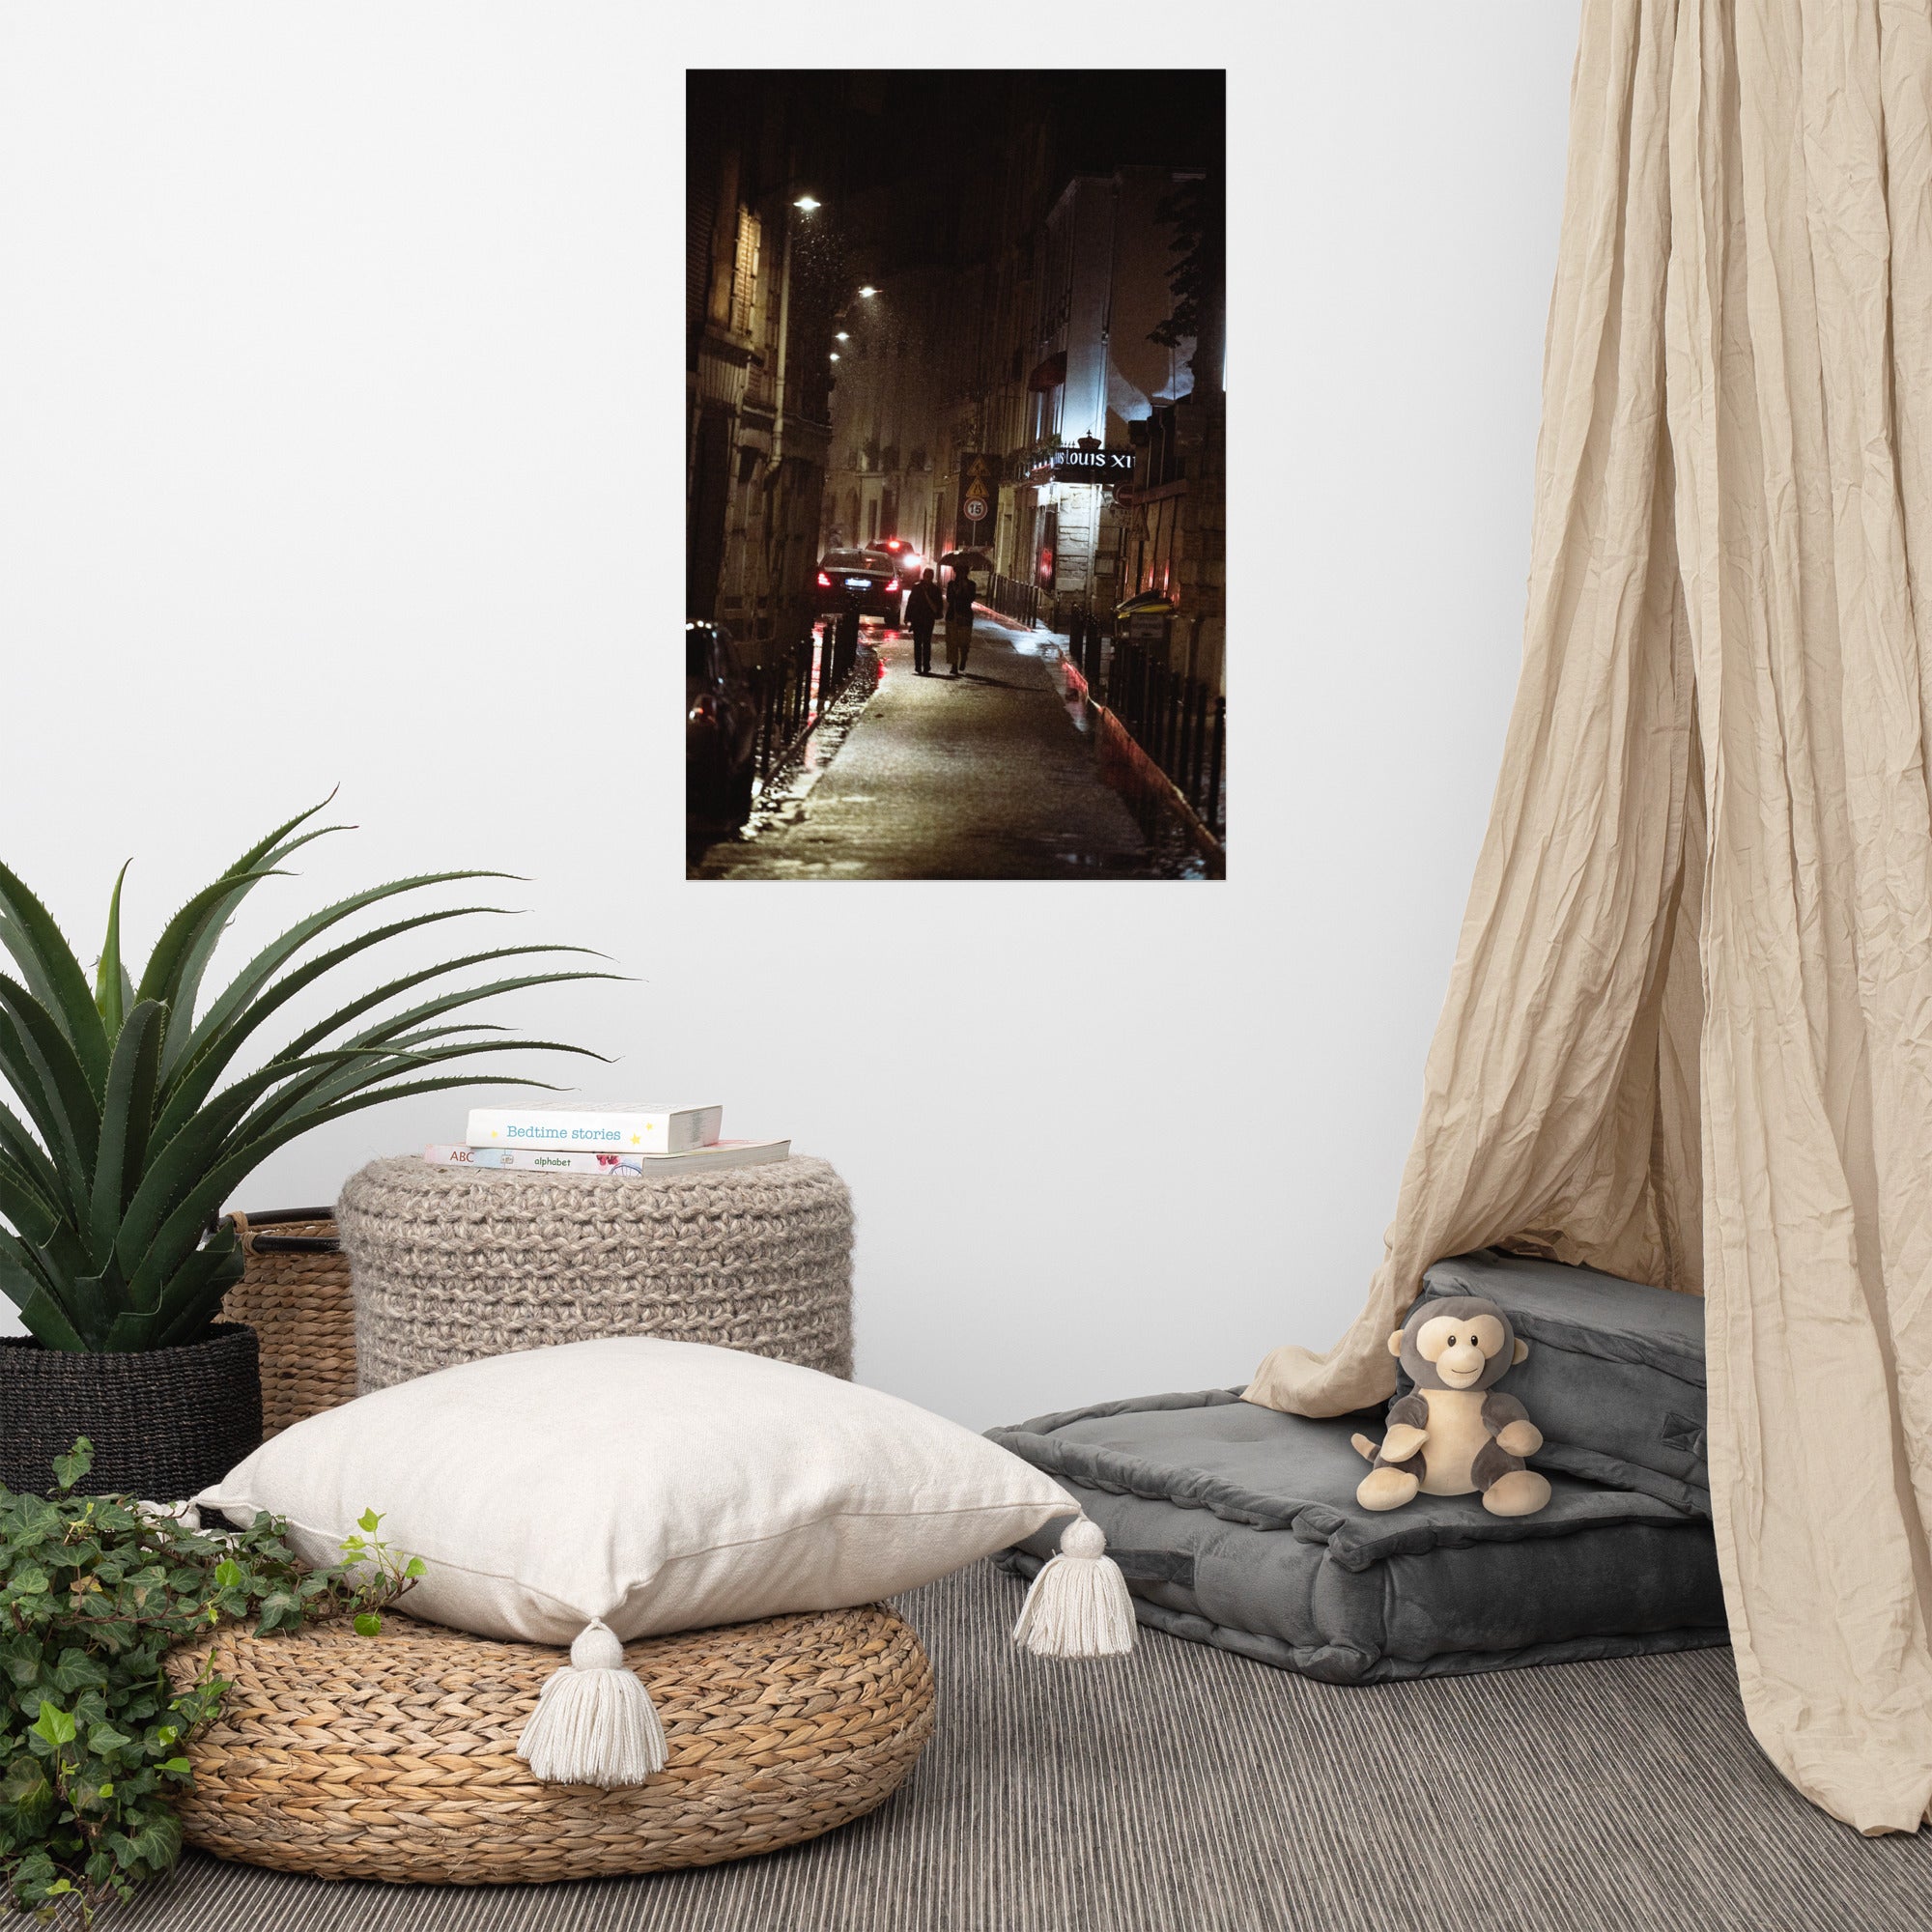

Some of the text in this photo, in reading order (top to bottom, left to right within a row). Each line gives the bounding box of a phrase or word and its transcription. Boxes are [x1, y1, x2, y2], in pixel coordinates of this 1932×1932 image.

[970, 503, 981, 514] 15
[506, 1125, 621, 1141] Bedtime stories
[449, 1151, 475, 1163] ABC
[534, 1157, 571, 1168] alphabet
